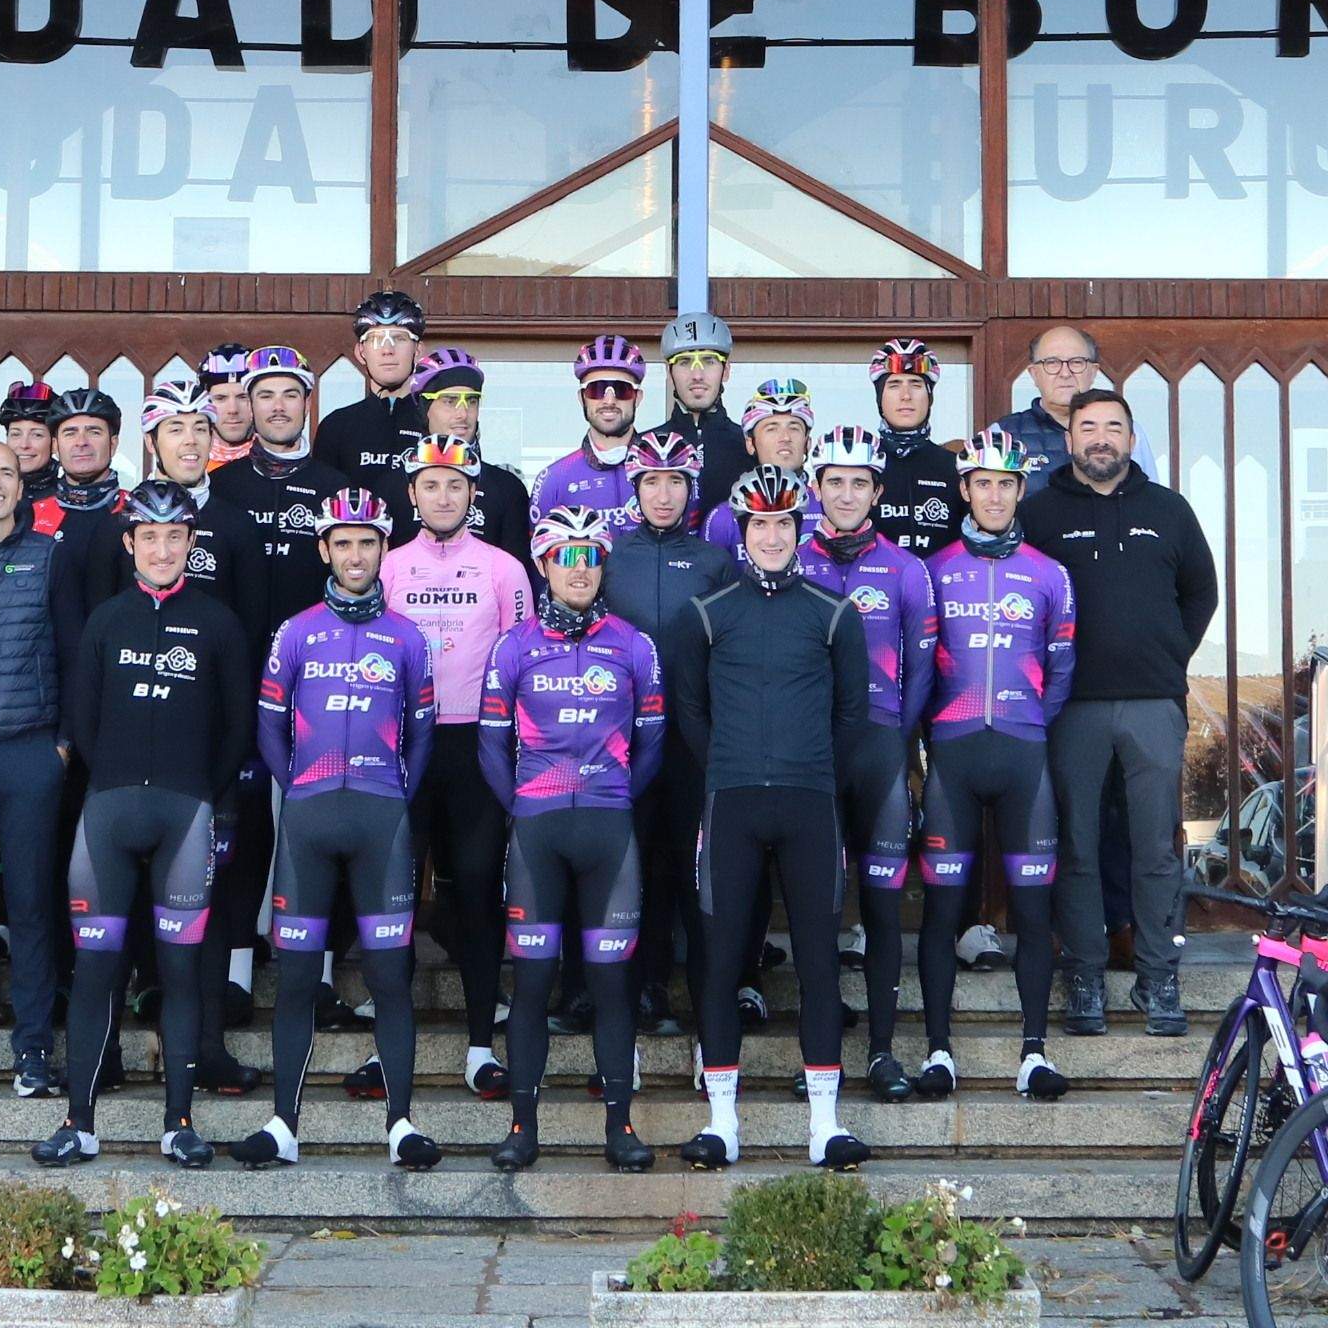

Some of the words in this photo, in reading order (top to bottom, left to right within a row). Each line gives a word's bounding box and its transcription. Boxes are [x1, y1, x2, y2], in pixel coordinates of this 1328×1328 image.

[248, 503, 317, 529] urgos
[406, 592, 478, 604] GOMUR
[514, 589, 524, 624] GOM
[943, 592, 1035, 622] Burgos
[419, 618, 464, 628] Cantabria
[968, 633, 1013, 649] BH
[119, 646, 197, 673] Burgos
[303, 653, 396, 683] Burgos
[533, 665, 617, 696] Burgos
[133, 683, 171, 699] BH
[325, 695, 371, 712] BH
[558, 708, 598, 723] BH
[869, 864, 895, 877] BH
[935, 863, 962, 875] BH
[1021, 864, 1048, 876] BH
[169, 892, 204, 903] HELIOS
[159, 918, 182, 932] BH
[375, 924, 404, 938] BH
[79, 927, 105, 939] BH
[279, 926, 307, 940] BH
[517, 934, 546, 946] BH
[599, 939, 628, 951] BH
